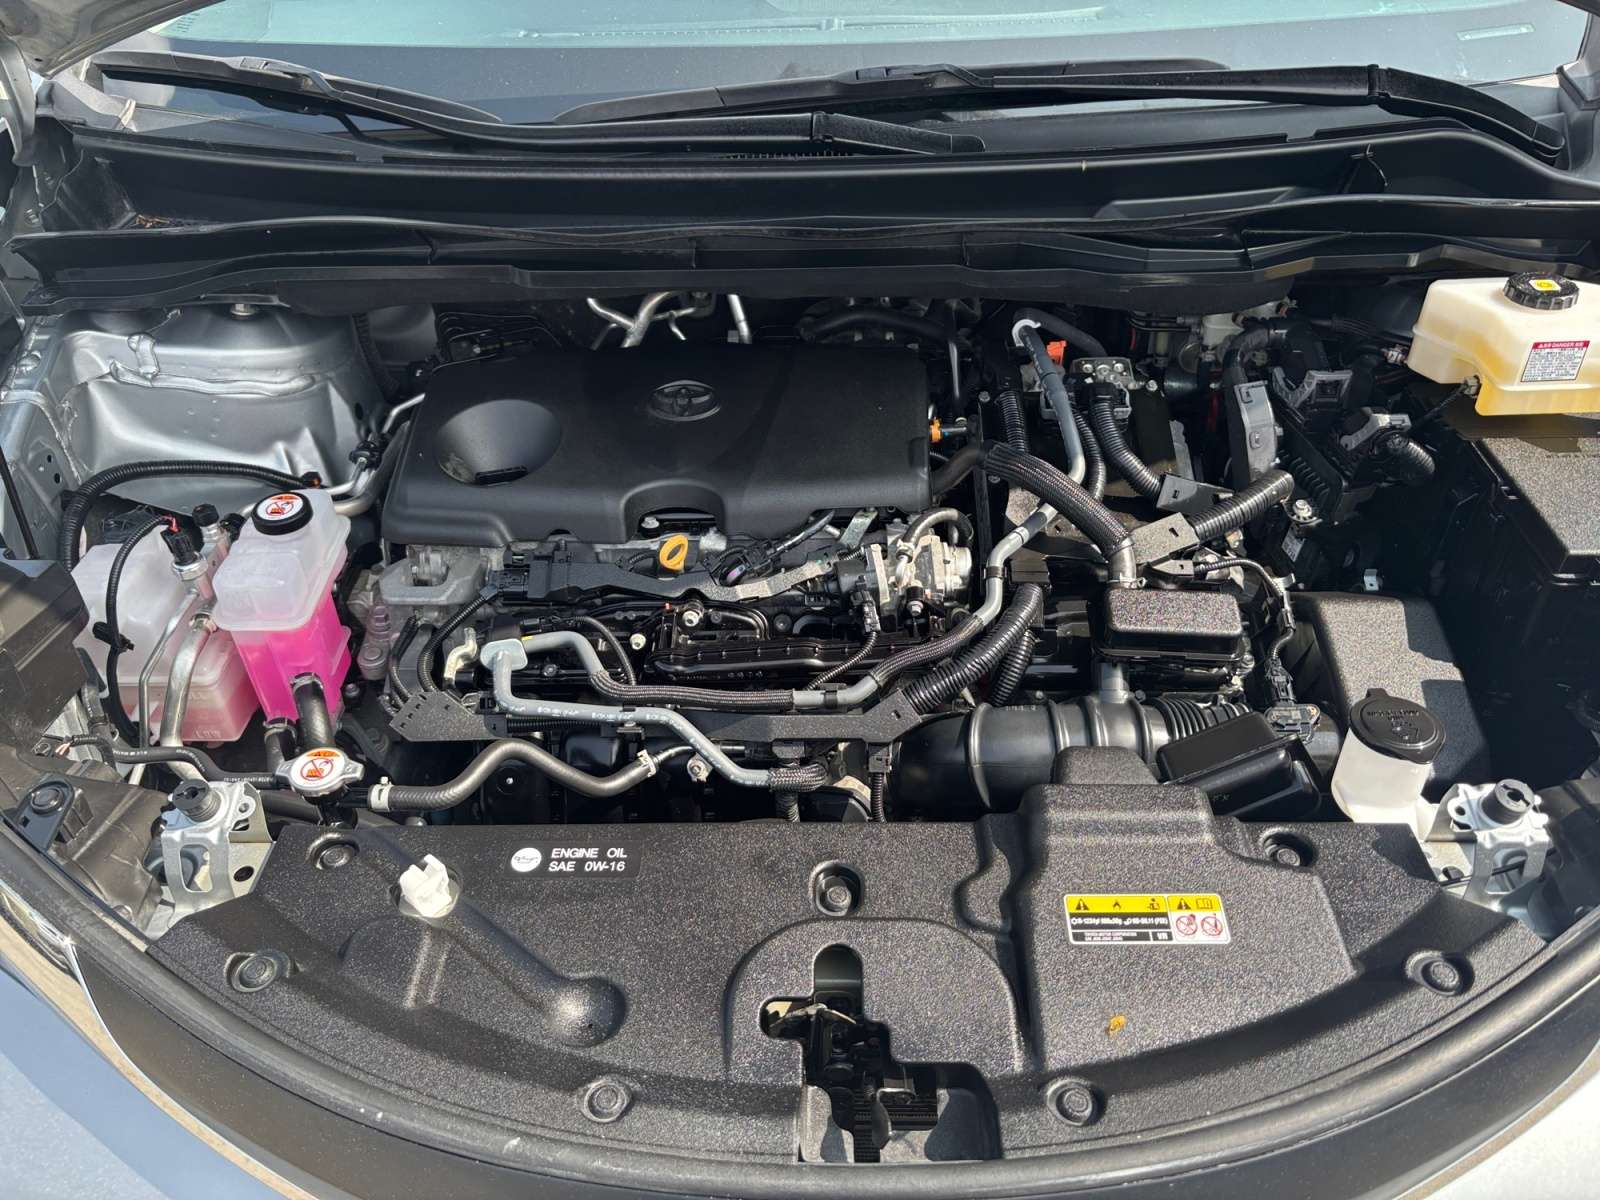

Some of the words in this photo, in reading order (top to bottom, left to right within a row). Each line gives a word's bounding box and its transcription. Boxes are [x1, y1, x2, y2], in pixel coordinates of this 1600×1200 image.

[551, 847, 600, 858] ENGINE
[606, 847, 628, 858] OIL
[548, 861, 576, 872] SAE
[584, 861, 626, 872] 0W-16
